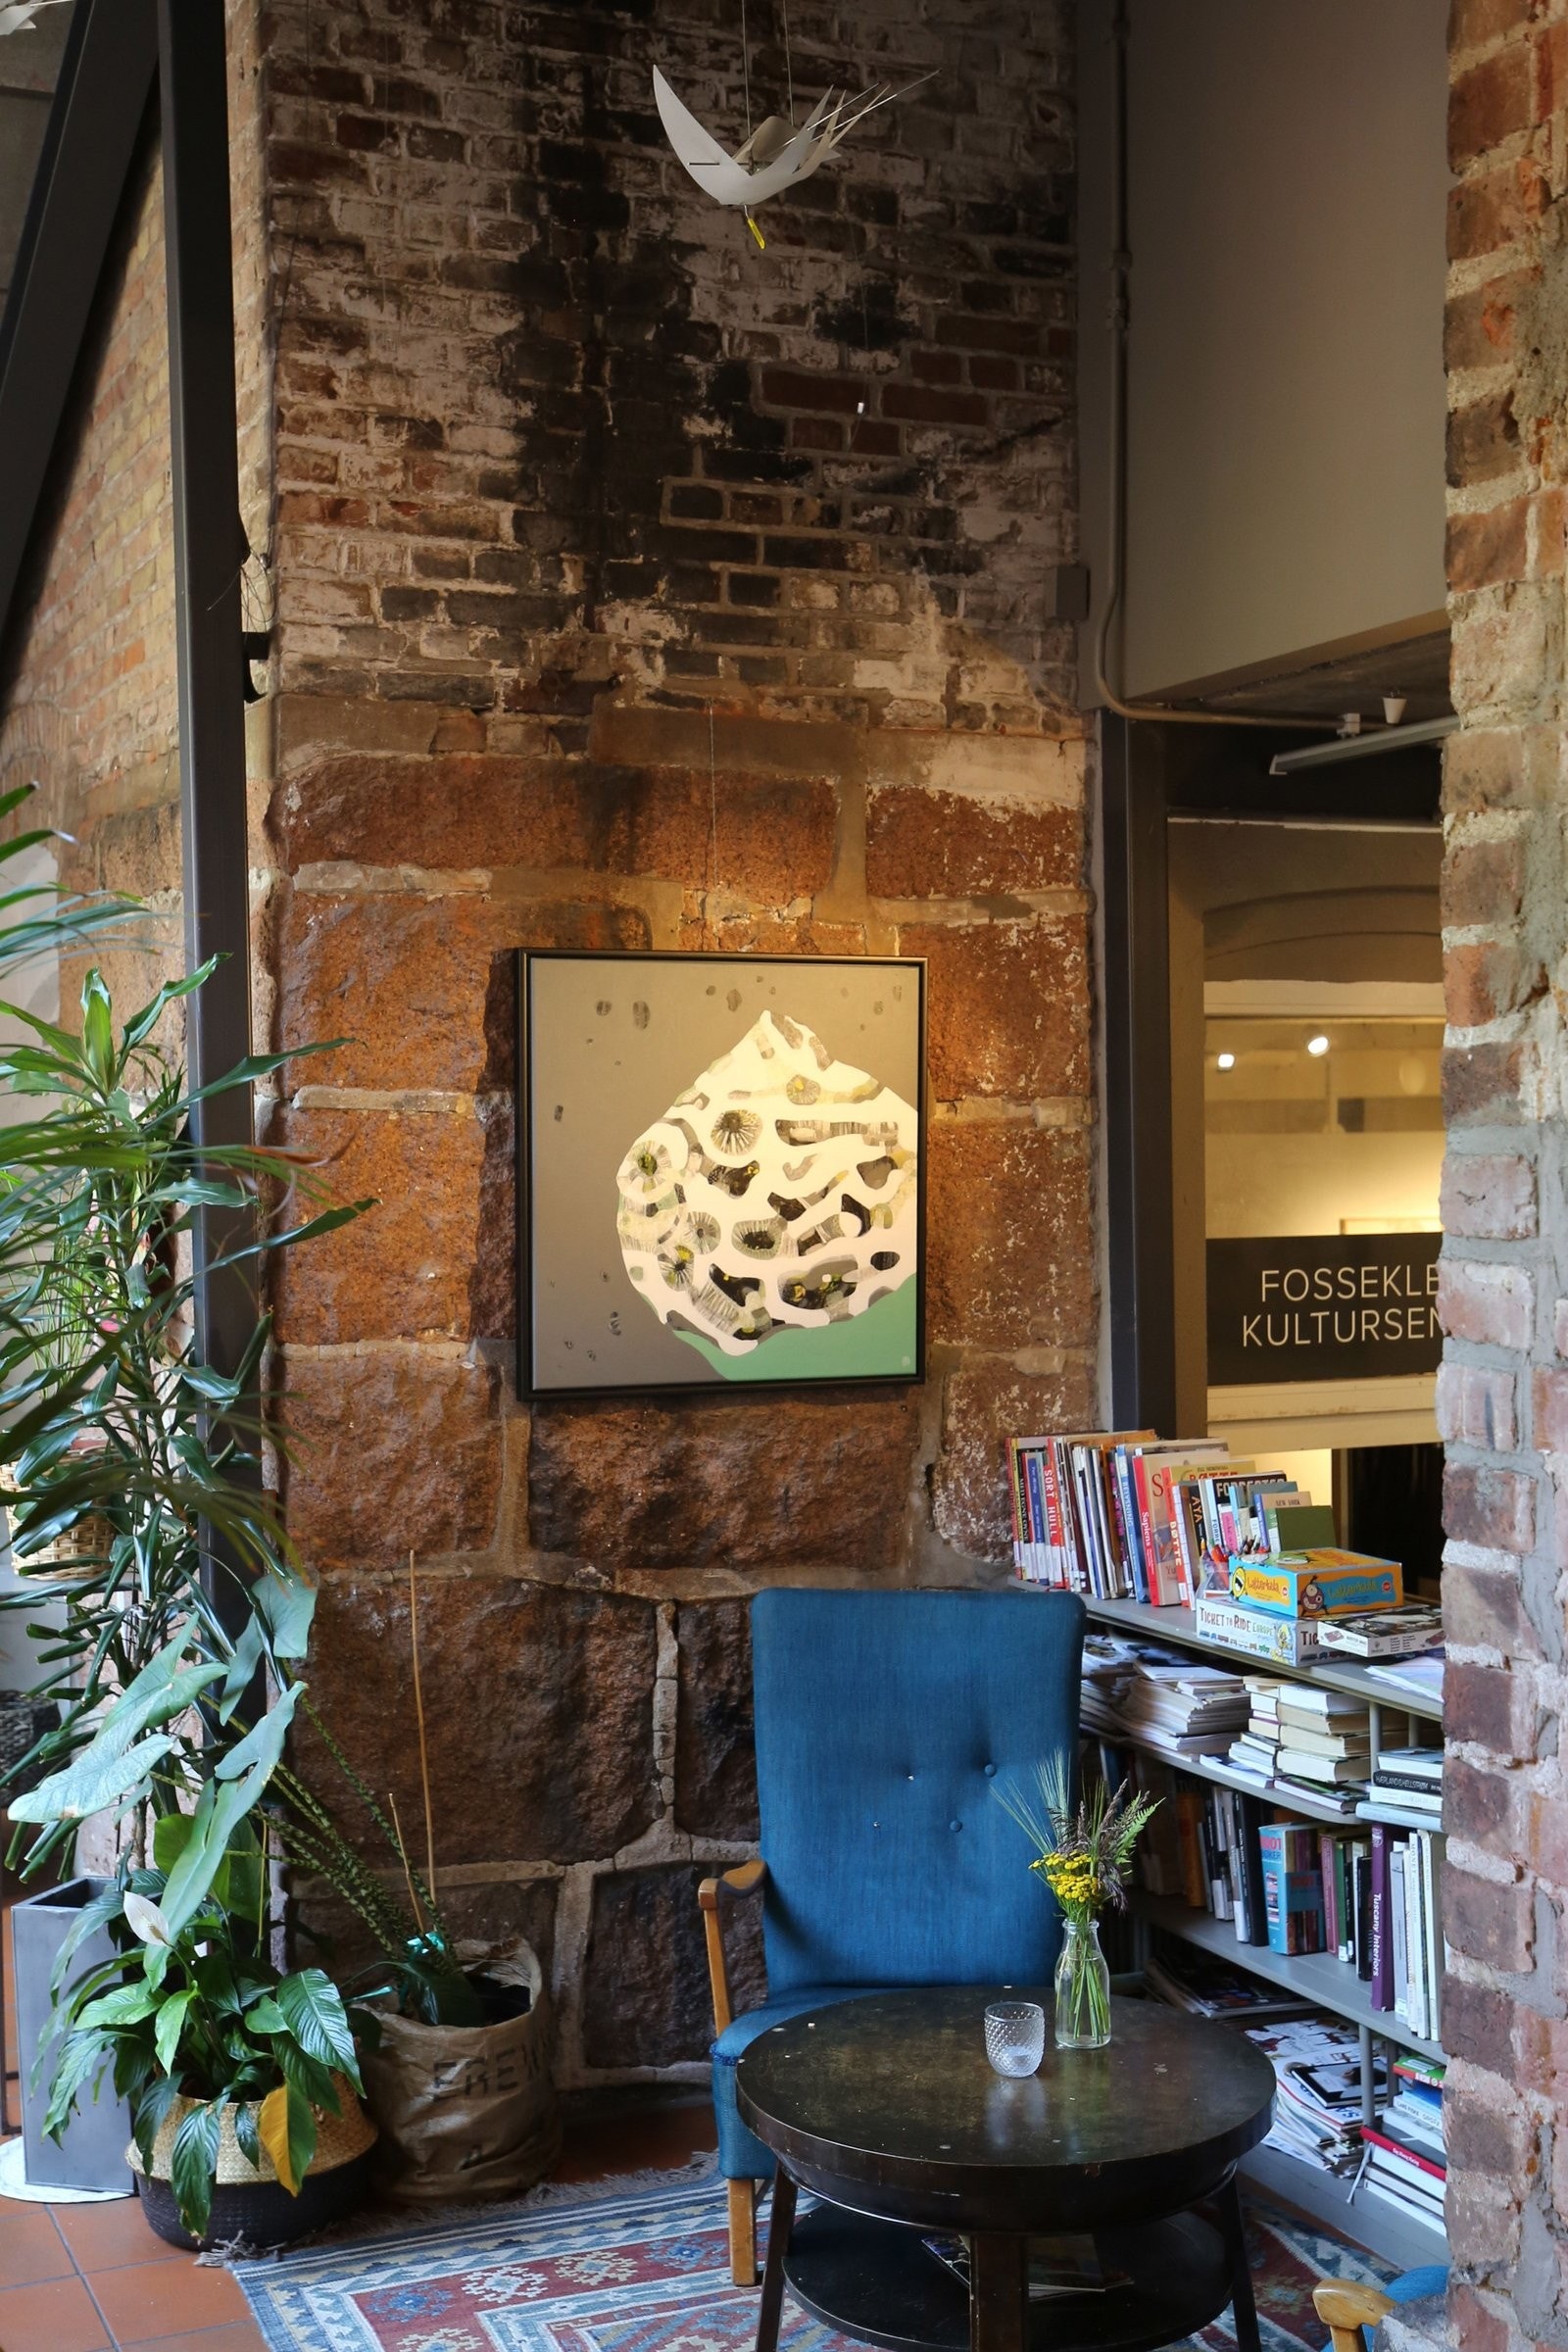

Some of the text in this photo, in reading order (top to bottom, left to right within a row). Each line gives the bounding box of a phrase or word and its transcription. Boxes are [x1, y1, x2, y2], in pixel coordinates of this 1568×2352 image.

[1261, 1264, 1438, 1303] FOSSEKLE
[1044, 1469, 1057, 1537] SORT HULL
[1191, 1495, 1203, 1523] AYA
[1141, 1511, 1152, 1546] Sapiens
[1169, 1521, 1182, 1567] BØTTE
[1373, 1892, 1382, 1933] Tuscany
